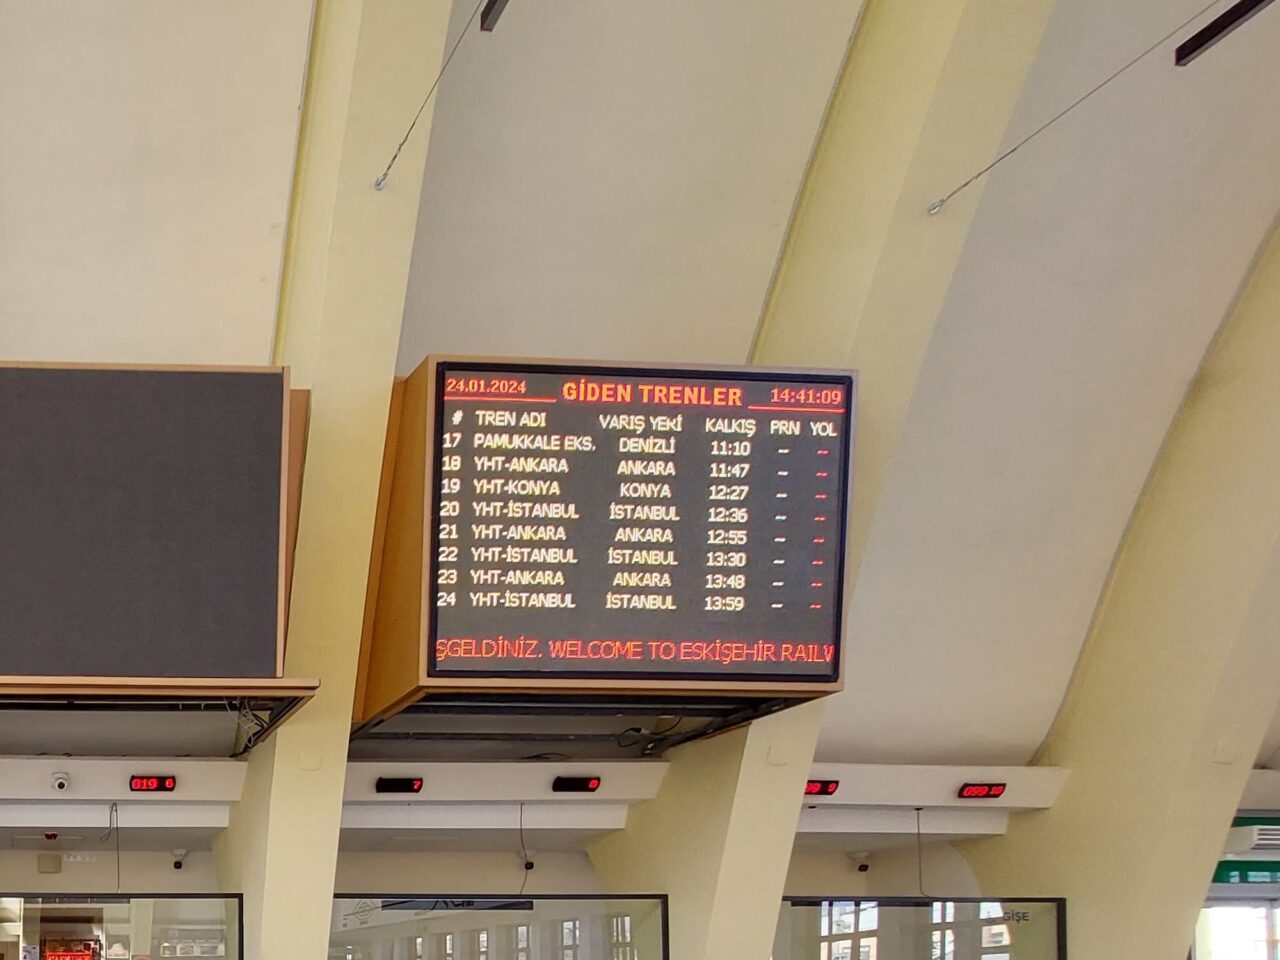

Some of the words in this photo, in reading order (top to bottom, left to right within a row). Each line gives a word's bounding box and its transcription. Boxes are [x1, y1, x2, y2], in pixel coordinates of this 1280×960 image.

[446, 378, 527, 394] 24.01.2024
[562, 378, 632, 403] GİDEN
[638, 385, 743, 407] TRENLER
[770, 388, 842, 404] 14:41:09
[475, 410, 516, 427] TREN
[519, 411, 547, 427] ADI
[599, 414, 645, 434] VARIŞ
[705, 417, 757, 438] KALKIŞ
[770, 420, 801, 435] PRN
[809, 421, 838, 437] YOL
[442, 432, 462, 448] 17
[473, 433, 561, 450] PAMUKKALE
[619, 436, 676, 454] DENİZLİ
[711, 441, 751, 456] 11:10
[442, 455, 461, 471] 18
[474, 455, 570, 474] YHT-ANKARA
[617, 460, 676, 477] ANKARA
[709, 463, 751, 478] 11:47
[441, 478, 461, 494] 19
[473, 478, 561, 496] YHT-KONYA
[620, 482, 671, 498] KONYA
[709, 485, 750, 500] 12:27
[439, 501, 460, 517] 20
[472, 499, 580, 519] YHT-İSTANBUL
[609, 502, 681, 521] İSTANBUL
[707, 507, 749, 523] 12:36
[439, 523, 459, 539] 21
[472, 524, 567, 541] YHT-ANKARA
[614, 527, 674, 544] ANKARA
[707, 529, 748, 545] 12:55
[438, 546, 458, 562] 22
[471, 545, 579, 564] YHT-İSTANBUL
[607, 547, 679, 566] İSTANBUL
[706, 551, 747, 567] 13:30
[437, 569, 458, 584] 23
[470, 569, 565, 586] YHT-ANKARA
[612, 572, 672, 588] ANKARA
[705, 574, 746, 589] 13:48
[436, 591, 457, 607] 24
[469, 590, 576, 608] YHT-İSTANBUL
[605, 592, 677, 610] İSTANBUL
[704, 596, 746, 612] 13:59
[548, 640, 643, 659] WELCOME
[647, 642, 676, 660] TO
[680, 639, 777, 665] ESKİŞEHİR
[1003, 909, 1030, 924] GİŞE
